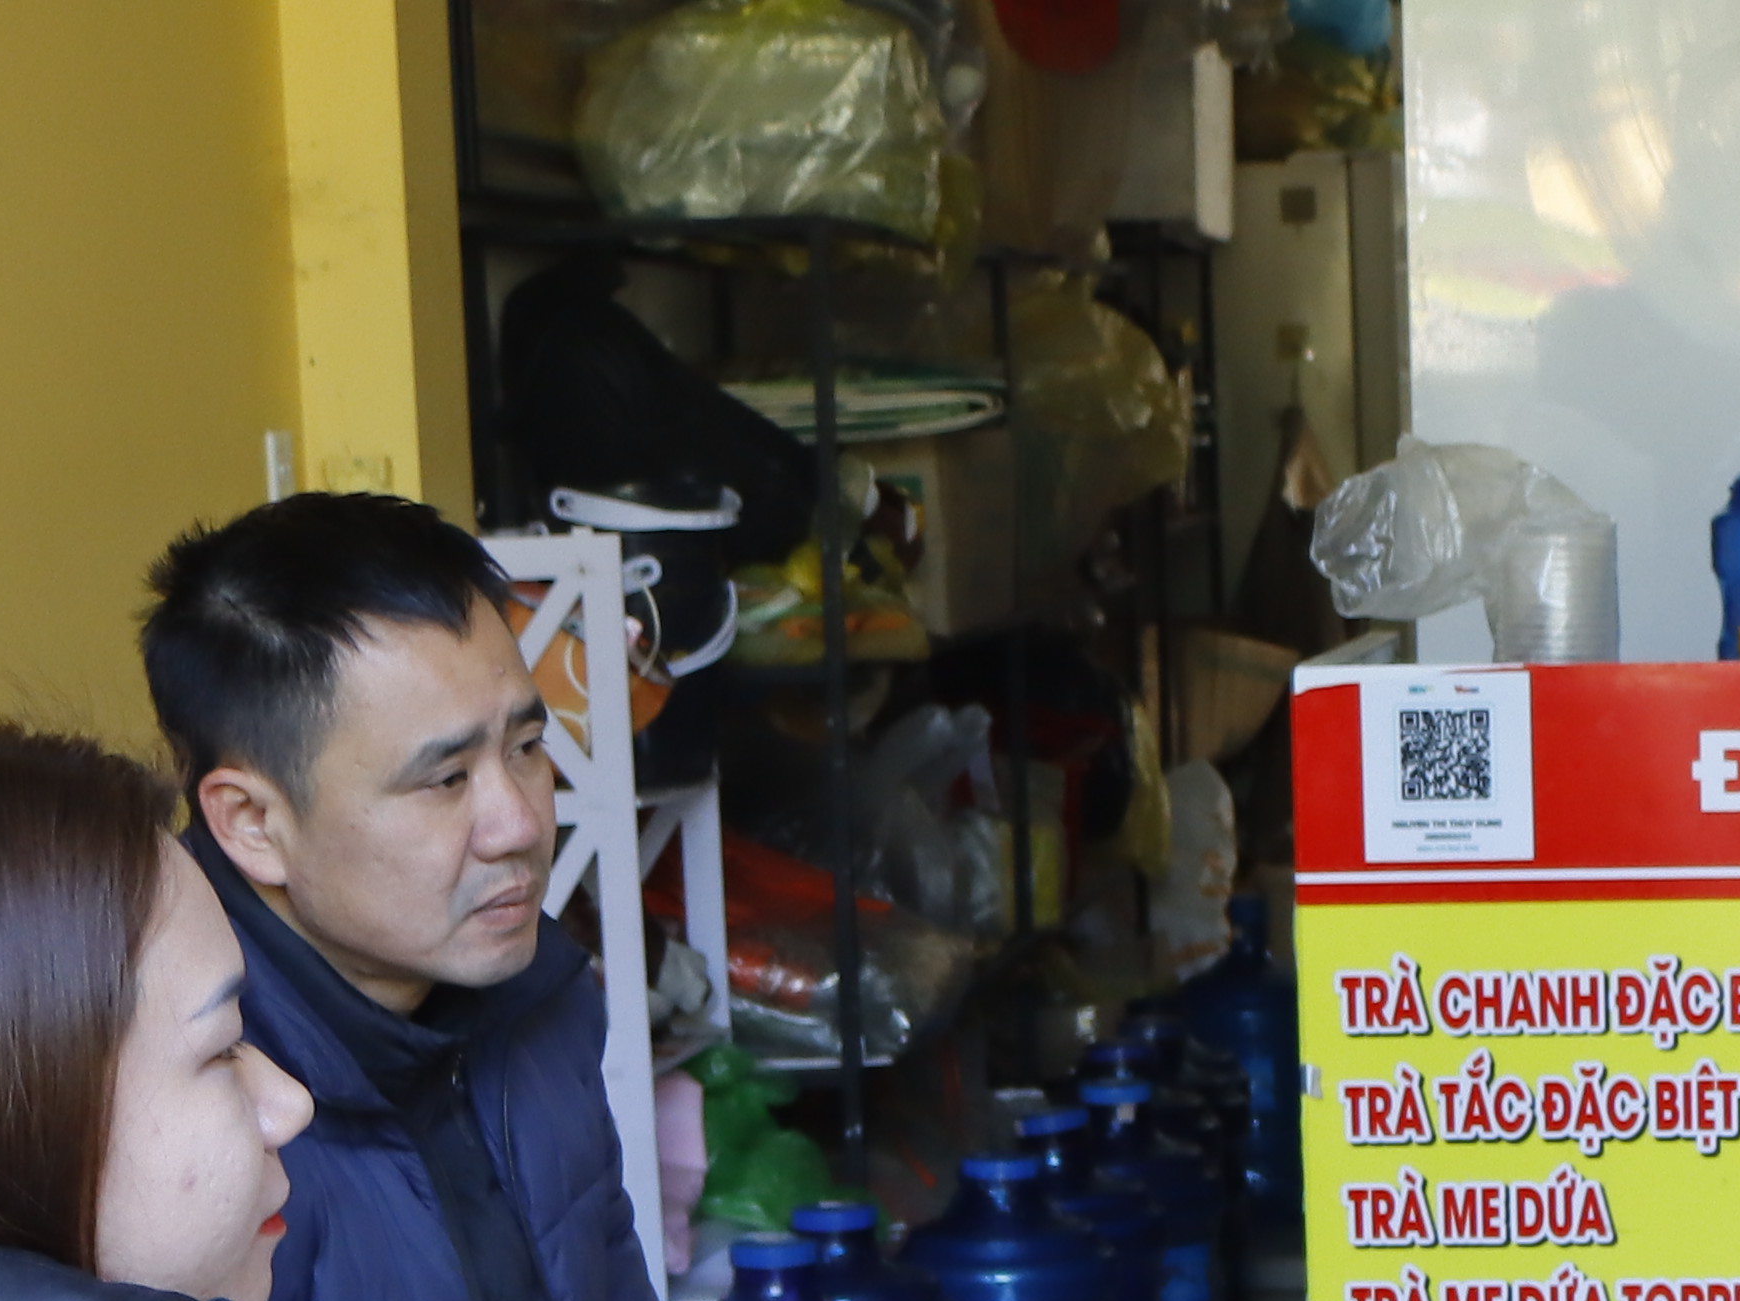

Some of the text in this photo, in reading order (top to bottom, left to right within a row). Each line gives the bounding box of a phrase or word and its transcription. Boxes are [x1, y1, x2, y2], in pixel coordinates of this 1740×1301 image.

[1338, 959, 1424, 1029] TRÀ
[1437, 973, 1601, 1031] CHANH
[1613, 960, 1715, 1043] ĐẶC
[1342, 1068, 1427, 1139] TRÀ
[1437, 1054, 1528, 1135] TẮC
[1539, 1066, 1641, 1149] ĐẶC
[1653, 1062, 1740, 1147] BIỆT
[1345, 1171, 1430, 1241] TRÀ
[1441, 1185, 1503, 1240] ME
[1514, 1169, 1609, 1240] DỨA
